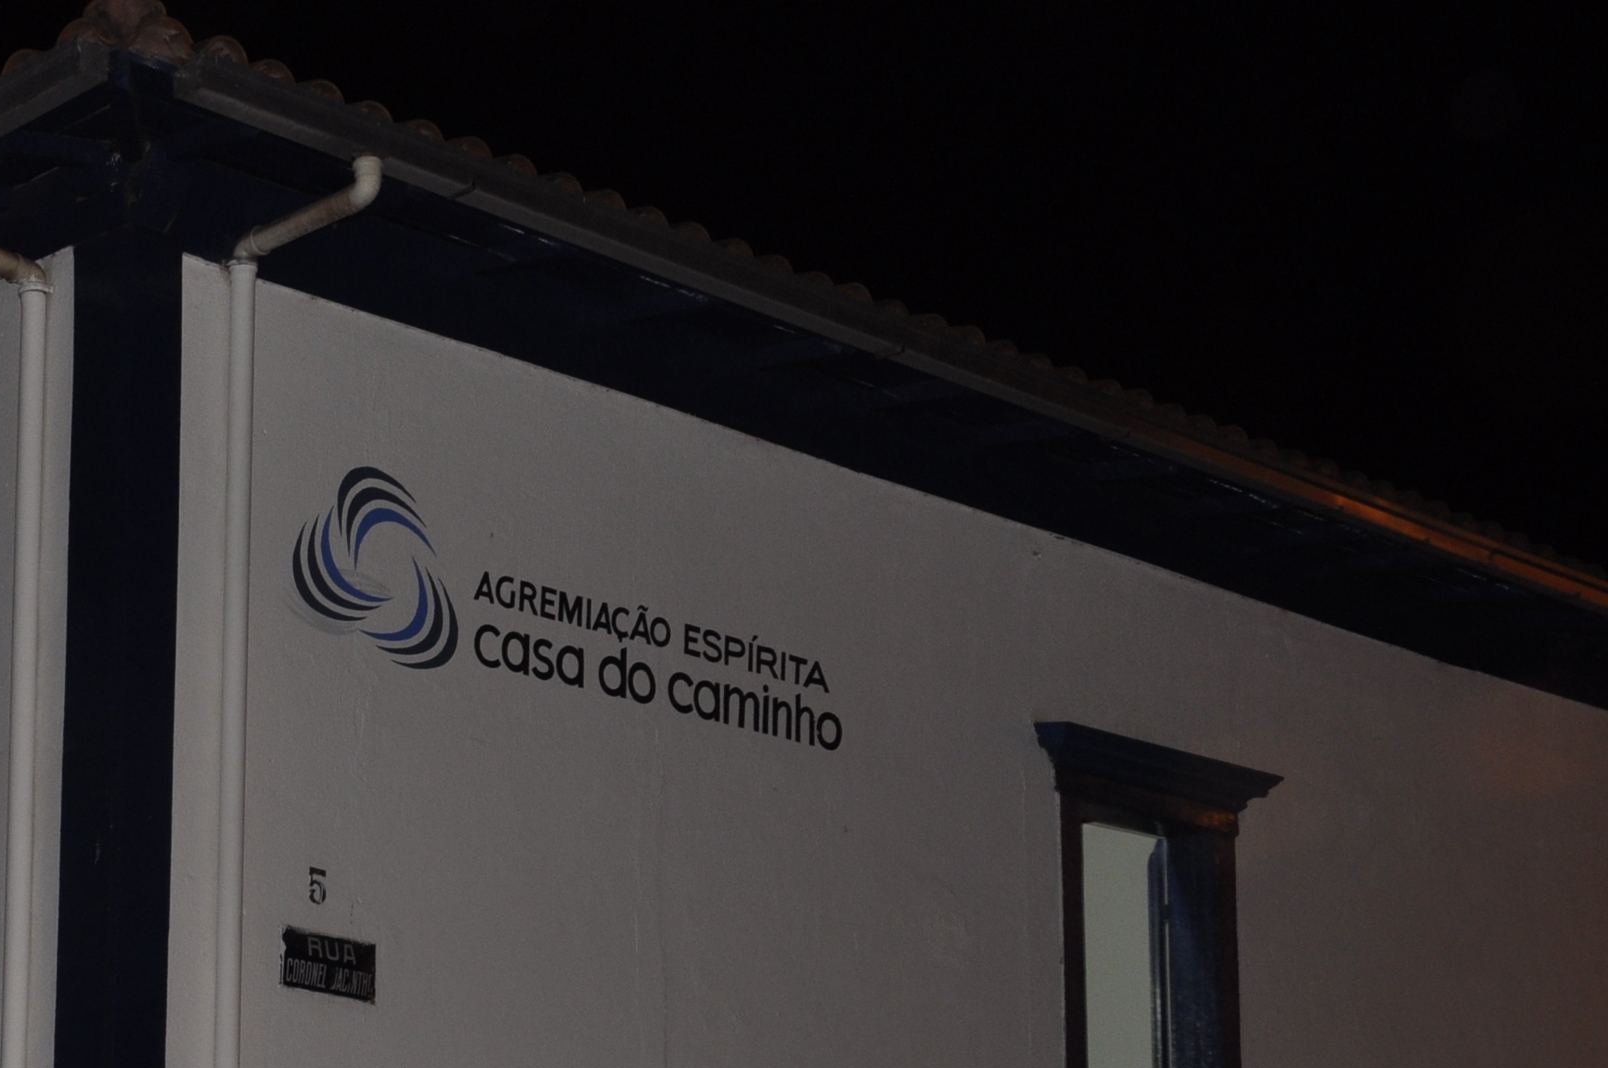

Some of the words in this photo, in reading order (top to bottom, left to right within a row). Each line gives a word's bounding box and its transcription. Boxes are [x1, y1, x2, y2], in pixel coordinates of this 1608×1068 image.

[472, 570, 672, 649] AGREMIAÇÃO
[682, 622, 831, 695] ESPÍRITA
[473, 623, 585, 690] casa
[597, 646, 657, 705] do
[666, 671, 844, 752] caminho
[308, 866, 327, 905] 5
[306, 935, 357, 965] RUA
[285, 957, 327, 989] CORONEL
